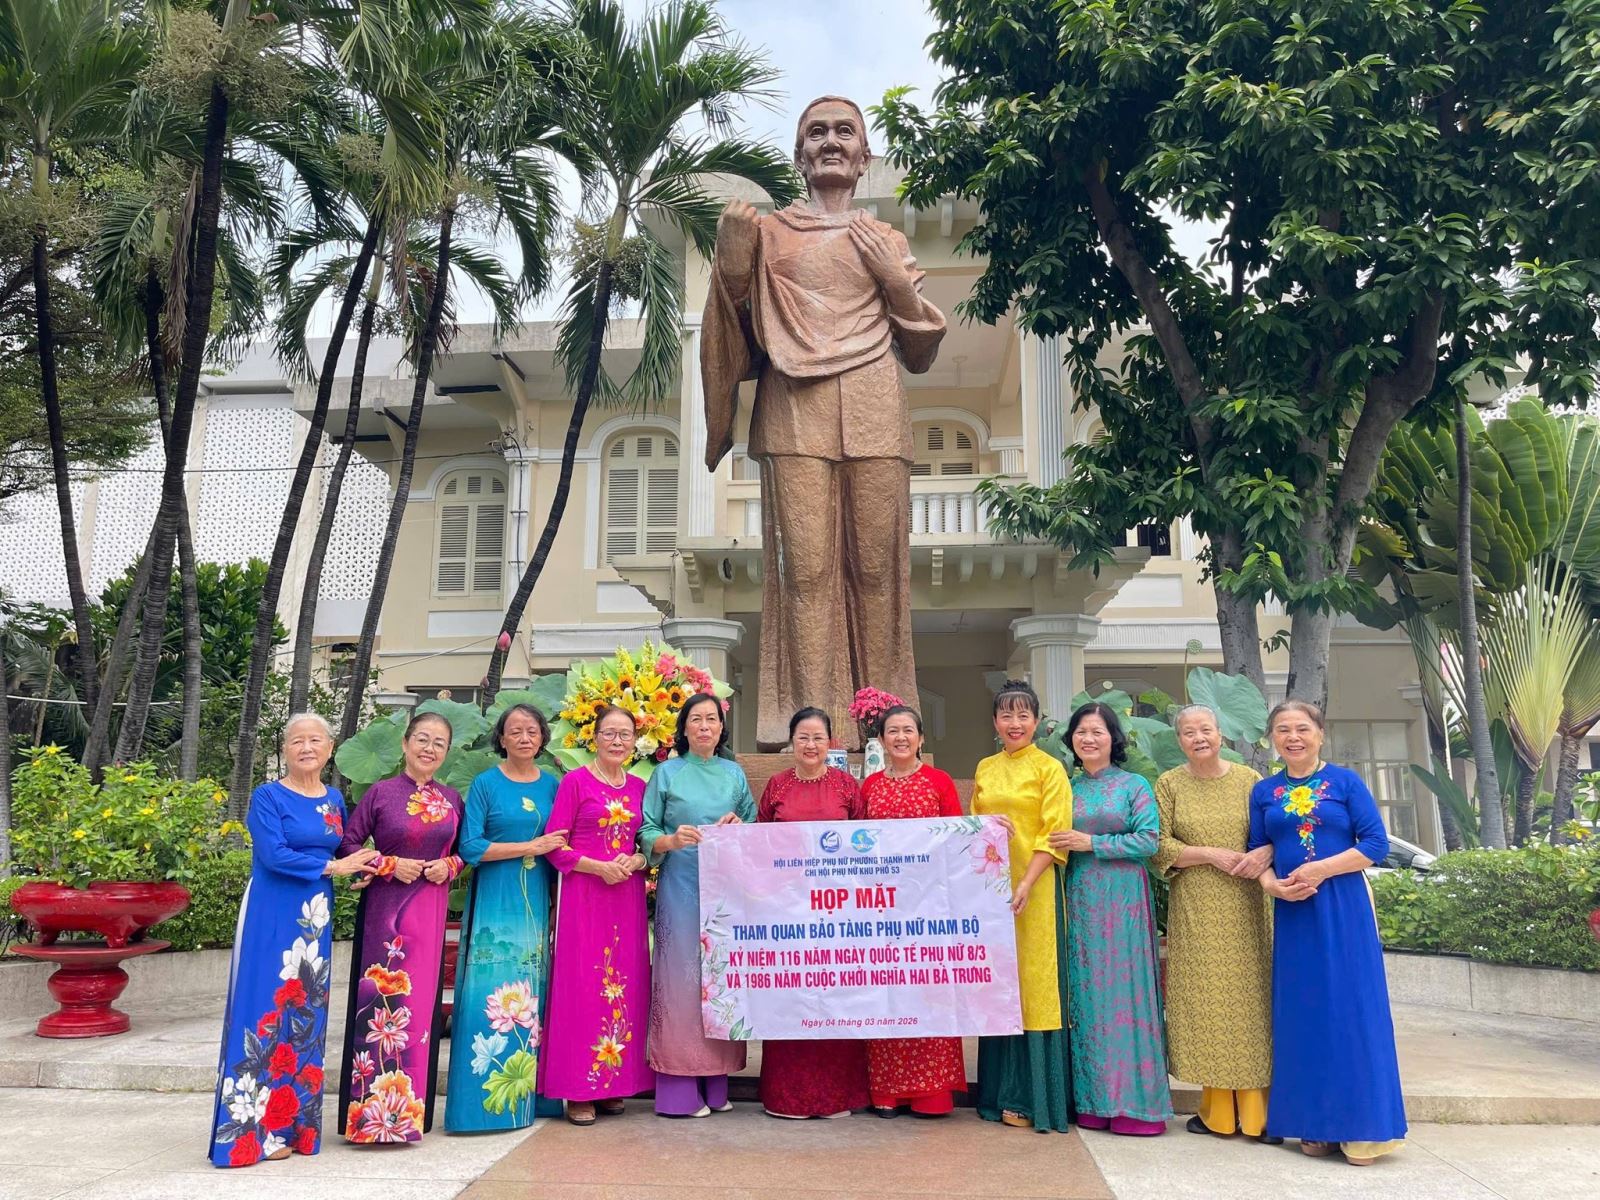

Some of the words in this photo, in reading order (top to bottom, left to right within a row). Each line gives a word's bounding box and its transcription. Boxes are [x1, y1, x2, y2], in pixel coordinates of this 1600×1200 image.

[774, 858, 785, 869] HỘI
[788, 858, 802, 867] LIÊN
[805, 858, 820, 868] HIỆP
[822, 858, 836, 868] PHỤ
[917, 854, 930, 862] TÂY
[818, 867, 830, 878] HỘI
[832, 868, 845, 877] PHỤ
[811, 889, 848, 914] HỌP
[856, 882, 896, 913] MẶT
[733, 925, 766, 940] THAM
[772, 924, 805, 941] QUAN
[810, 918, 835, 938] BẢO
[839, 919, 872, 937] TÀNG
[877, 921, 902, 939] PHỤ
[906, 917, 925, 935] NỮ
[928, 919, 957, 935] NAM
[962, 916, 979, 938] BỘ
[730, 946, 744, 966] KỶ
[748, 948, 775, 969] NIỆM
[780, 950, 800, 966] 116
[805, 947, 830, 965] NĂM
[835, 946, 865, 964] NGÀY
[869, 942, 900, 965] QUỐC
[903, 942, 917, 962] TẾ
[921, 946, 944, 965] PHỤ
[948, 943, 964, 962] NỮ
[968, 945, 986, 961] 8/3
[726, 970, 741, 988] VÀ
[745, 973, 771, 988] 1986
[775, 970, 801, 988] NĂM
[805, 969, 836, 990] CUỘC
[840, 966, 866, 986] KHỞI
[871, 967, 906, 985] NGHĨA
[910, 969, 929, 985] HAI
[933, 965, 949, 984] BÀ
[952, 966, 991, 983] TRƯNG
[802, 1018, 823, 1028] Ngày
[838, 1018, 862, 1027] tháng
